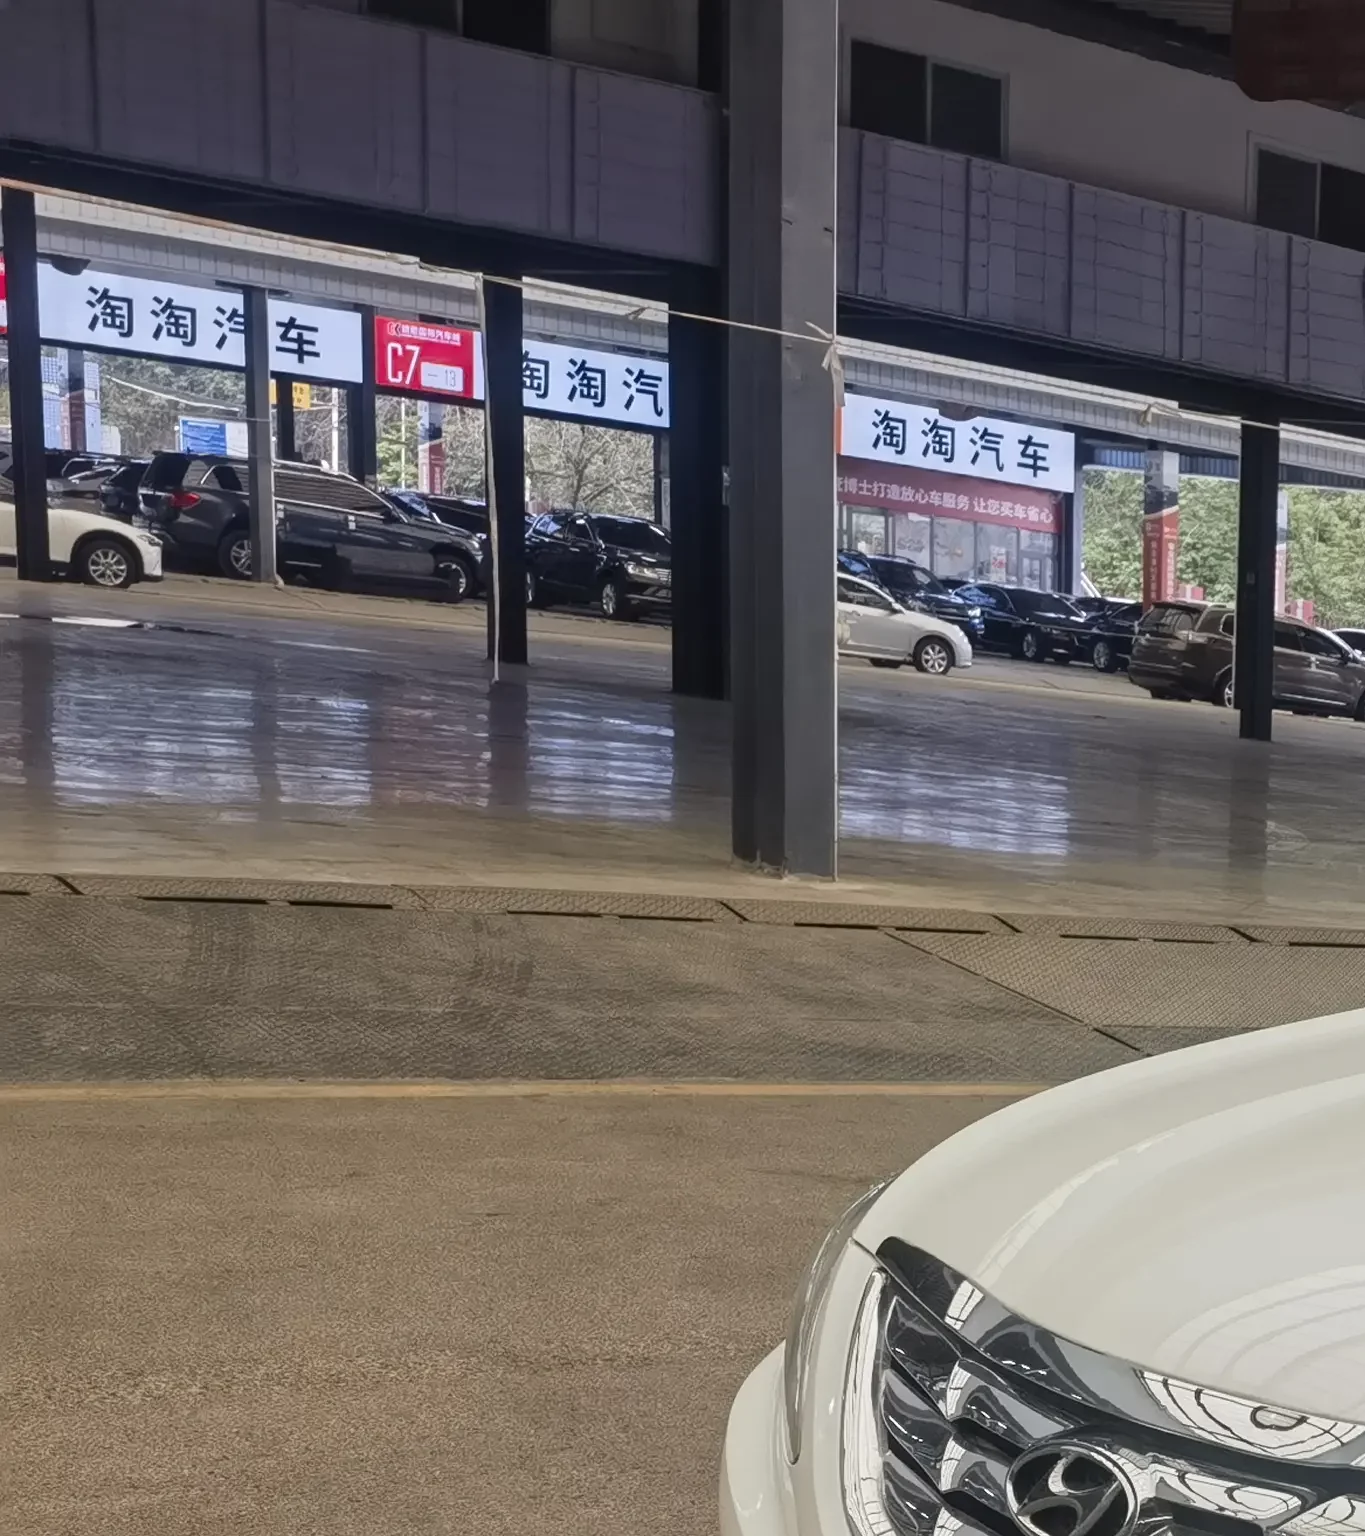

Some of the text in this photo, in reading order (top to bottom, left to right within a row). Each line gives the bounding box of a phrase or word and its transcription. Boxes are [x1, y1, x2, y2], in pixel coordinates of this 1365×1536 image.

[387, 342, 420, 385] C7
[872, 408, 1050, 478] 淘淘汽车
[973, 496, 1054, 524] 让您买车省心
